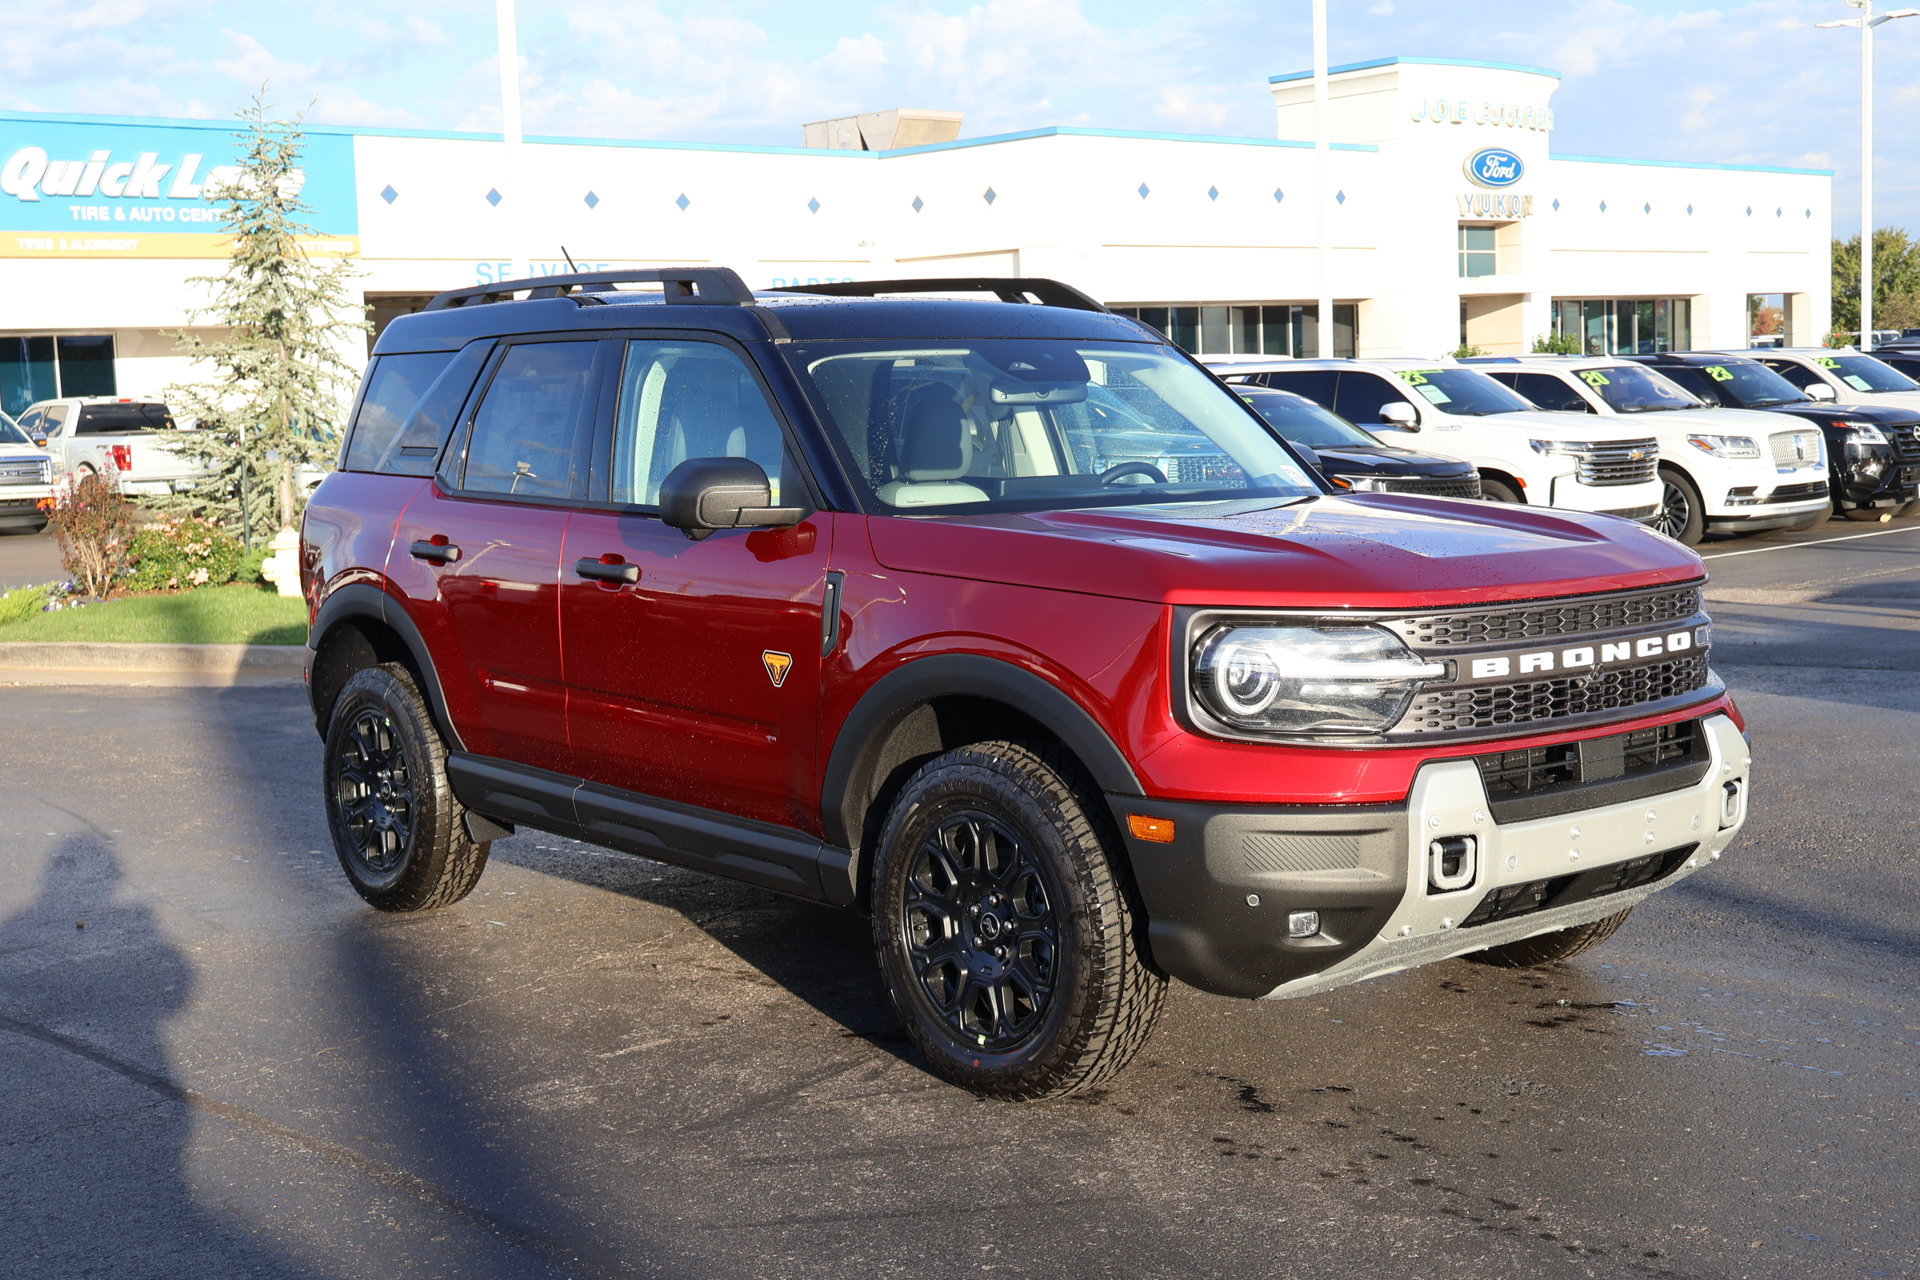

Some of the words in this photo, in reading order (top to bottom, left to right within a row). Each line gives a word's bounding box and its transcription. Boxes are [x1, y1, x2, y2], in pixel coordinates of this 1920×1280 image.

[1411, 98, 1468, 125] JOE
[1, 146, 173, 202] Quick
[1482, 154, 1516, 180] Ford
[69, 206, 110, 221] TIRE
[115, 206, 126, 222] &
[130, 207, 176, 222] AUTO
[178, 207, 244, 223] CENT
[1456, 194, 1533, 219] YUKON
[17, 238, 54, 250] TIRES
[1579, 371, 1611, 387] 20
[1705, 366, 1734, 381] 23
[1471, 631, 1691, 679] BRONCO
